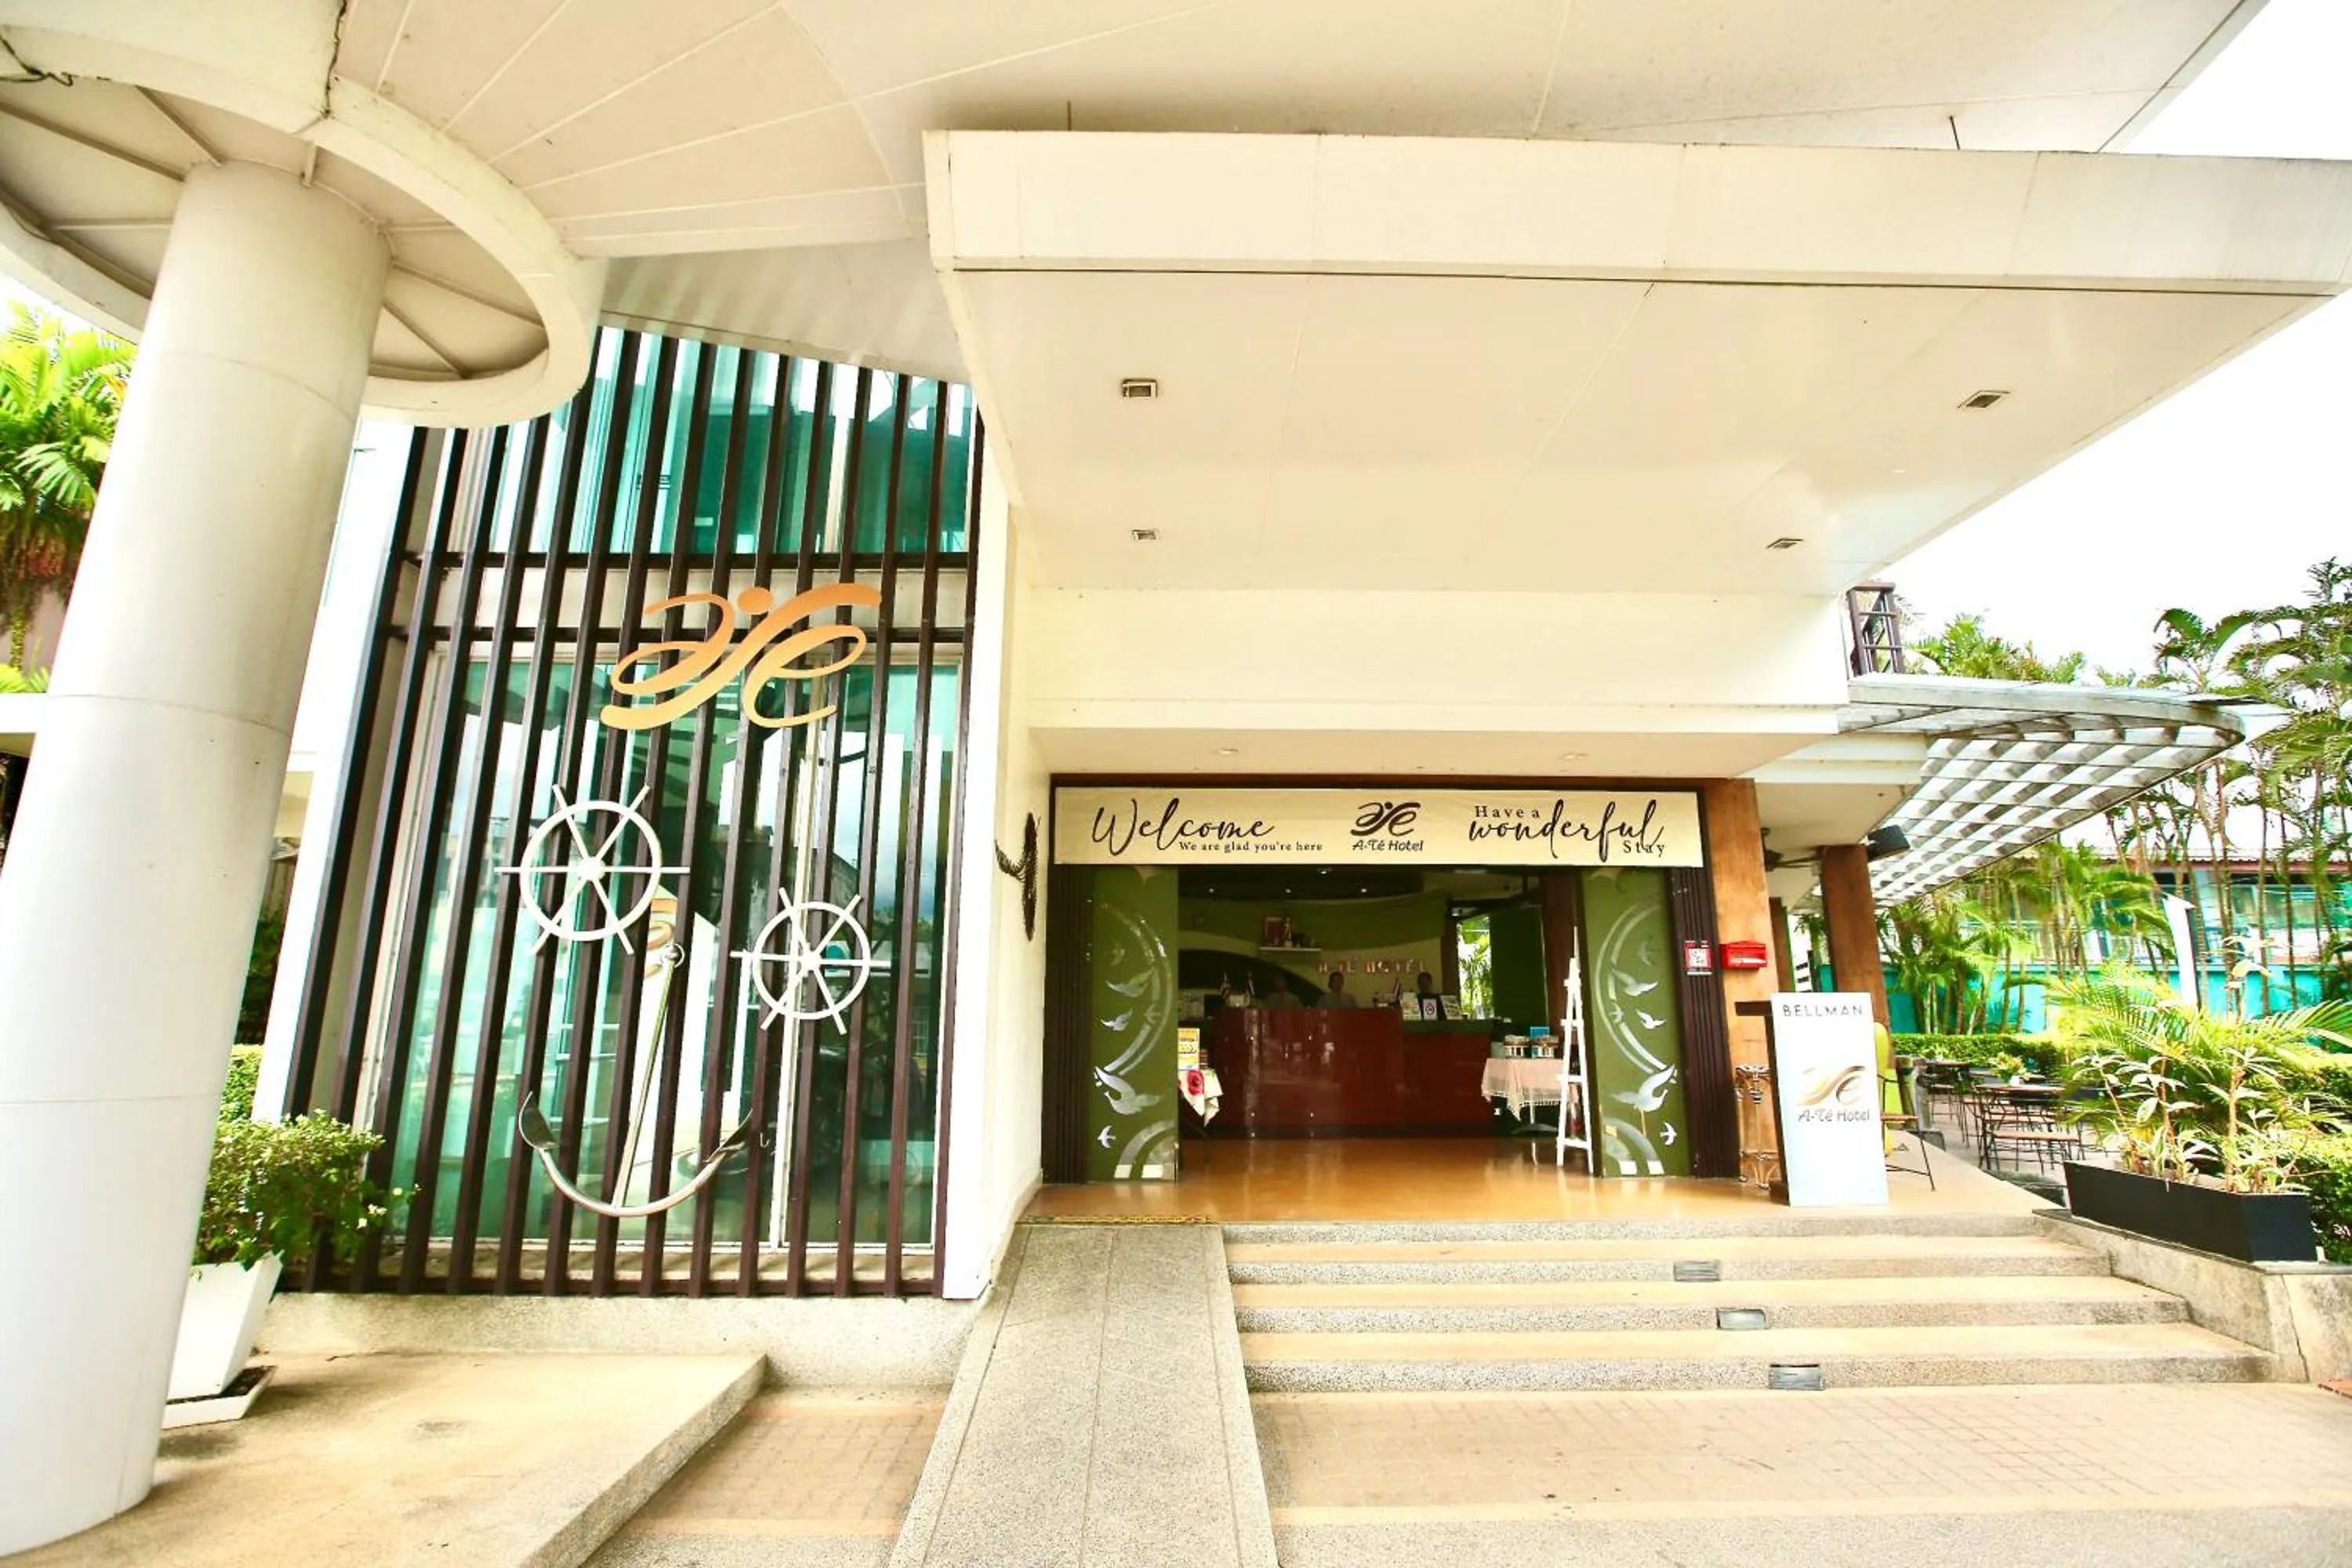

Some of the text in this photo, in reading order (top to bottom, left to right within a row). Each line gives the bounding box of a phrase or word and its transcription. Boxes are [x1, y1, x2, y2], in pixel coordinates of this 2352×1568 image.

[1475, 805, 1541, 819] Have a
[1091, 797, 1276, 856] Welcome
[1468, 799, 1664, 862] wonderful
[1178, 841, 1197, 851] We
[1224, 841, 1250, 853] glad
[1254, 841, 1291, 853] you're
[1296, 841, 1323, 851] here
[1388, 840, 1424, 851] Hotel
[1623, 840, 1665, 858] Stay
[1782, 1004, 1863, 1017] BELLMAN
[1837, 1109, 1870, 1122] Hotel
